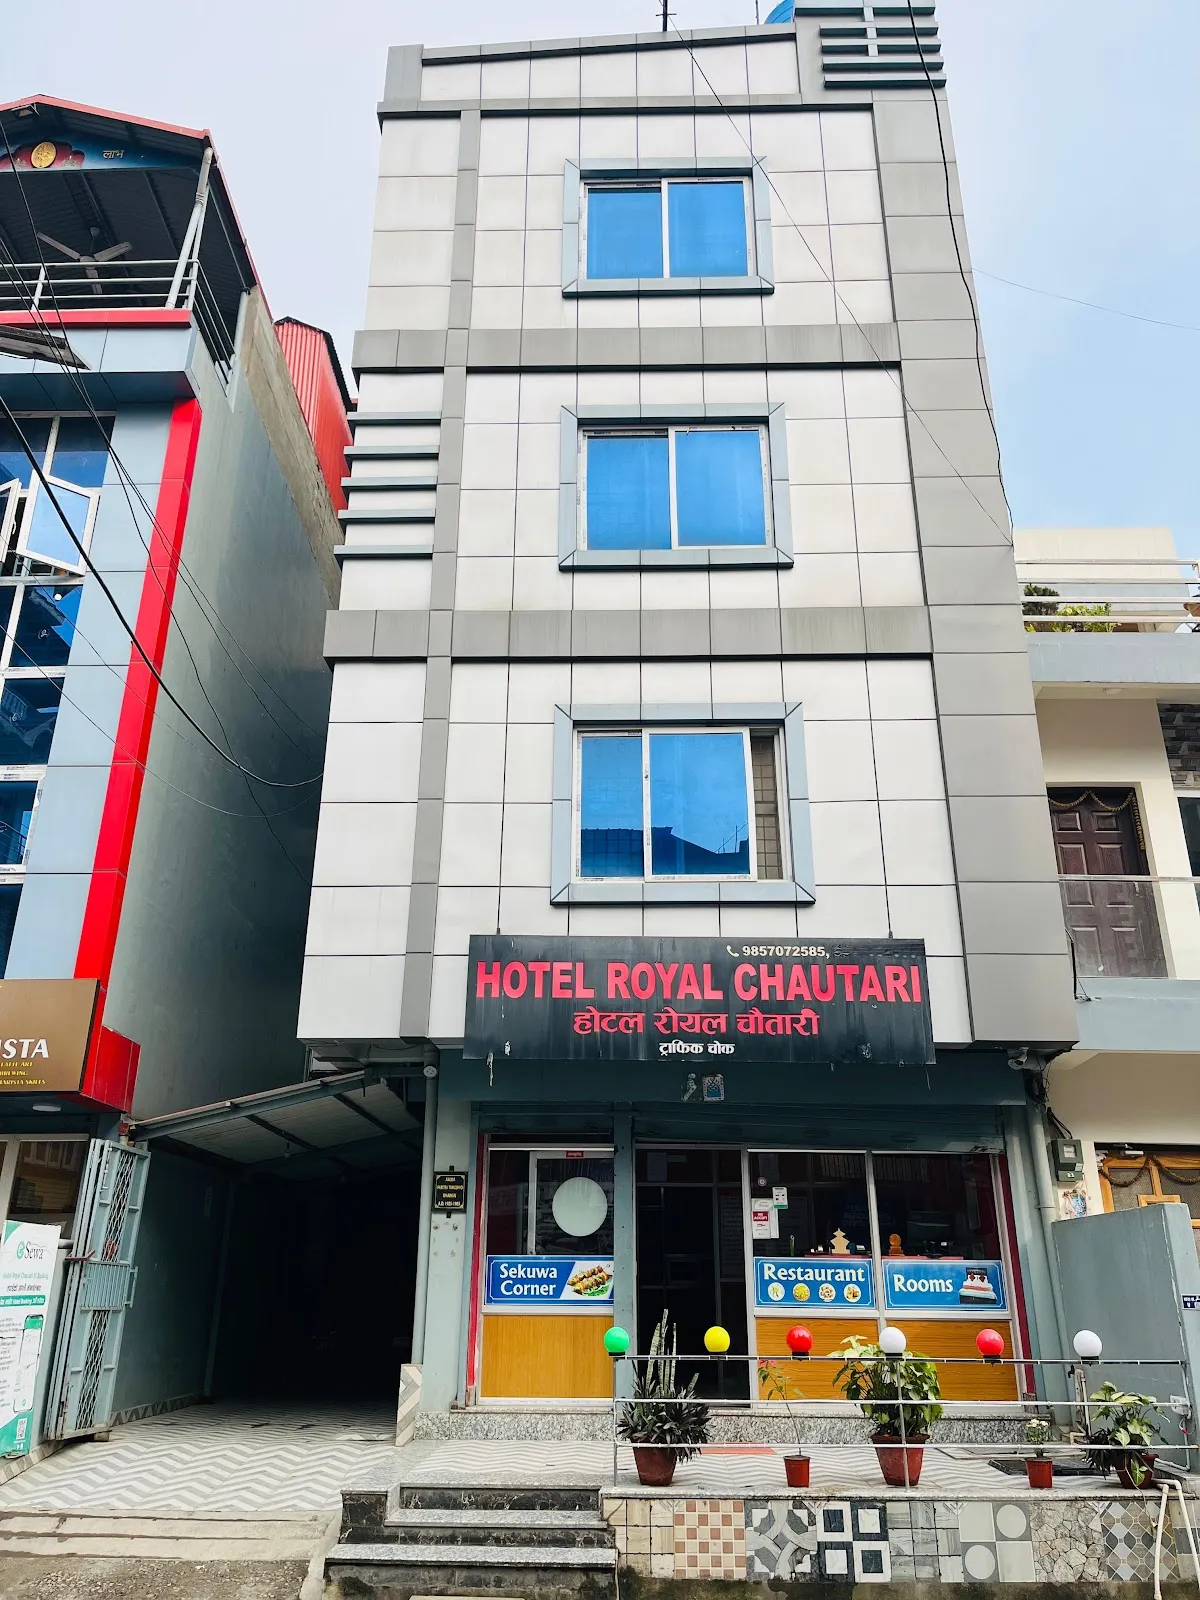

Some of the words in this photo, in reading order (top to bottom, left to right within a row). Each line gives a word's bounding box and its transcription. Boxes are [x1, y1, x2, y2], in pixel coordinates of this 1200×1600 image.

[103, 149, 125, 159] लाभ
[476, 961, 595, 999] HOTEL
[607, 962, 724, 1000] ROYAL
[733, 963, 922, 1003] CHAUTARI
[573, 1006, 646, 1035] होटल
[654, 1006, 729, 1035] रोयल
[736, 1007, 820, 1036] चौतारी
[659, 1038, 704, 1057] ट्राफिक
[707, 1040, 736, 1055] चोक
[500, 1263, 557, 1279] Sekuwa
[763, 1263, 866, 1282] Restaurant
[500, 1280, 556, 1296] Corner
[893, 1274, 954, 1293] Rooms
